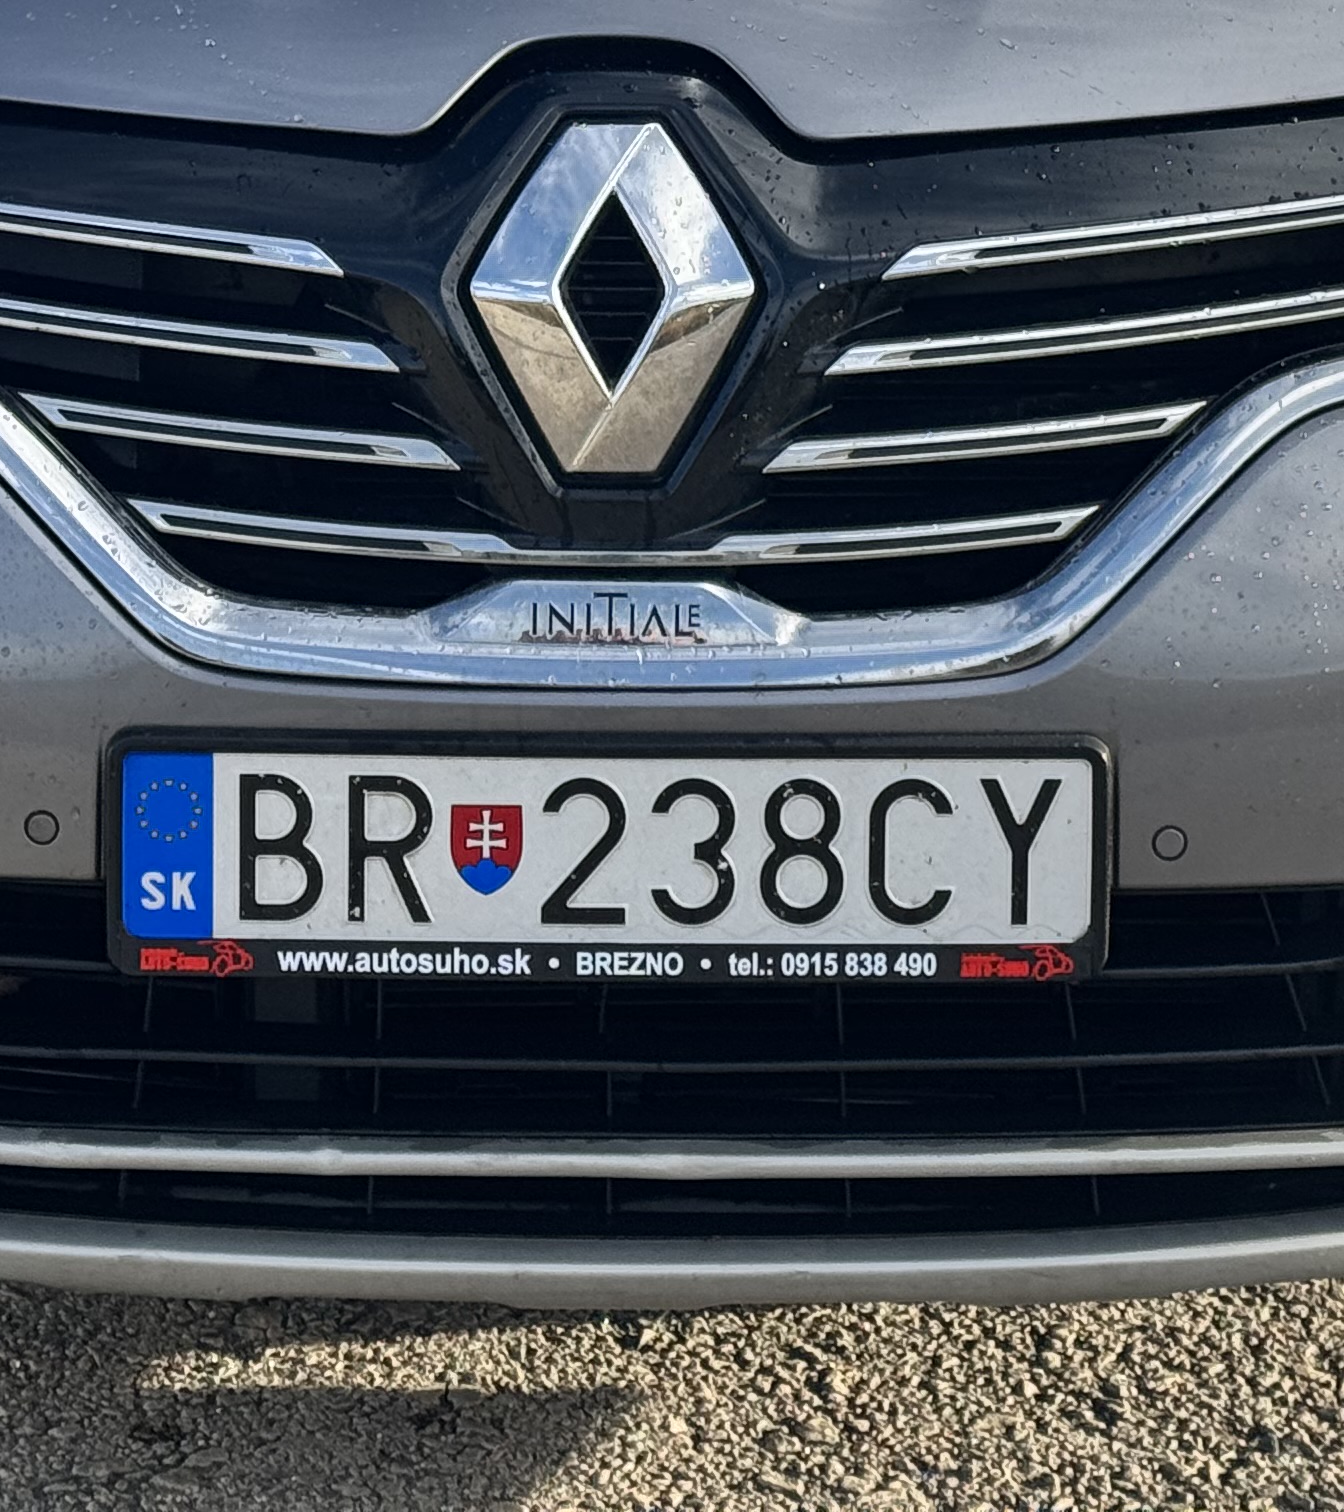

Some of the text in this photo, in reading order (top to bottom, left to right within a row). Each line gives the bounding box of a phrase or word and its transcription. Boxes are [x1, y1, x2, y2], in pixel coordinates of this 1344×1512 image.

[530, 592, 702, 639] INITIALE
[239, 773, 1064, 926] BR 238CY
[140, 871, 196, 910] SK
[277, 948, 937, 977] www.autosuho.sk BREZNO tel.: 0915 838 490
